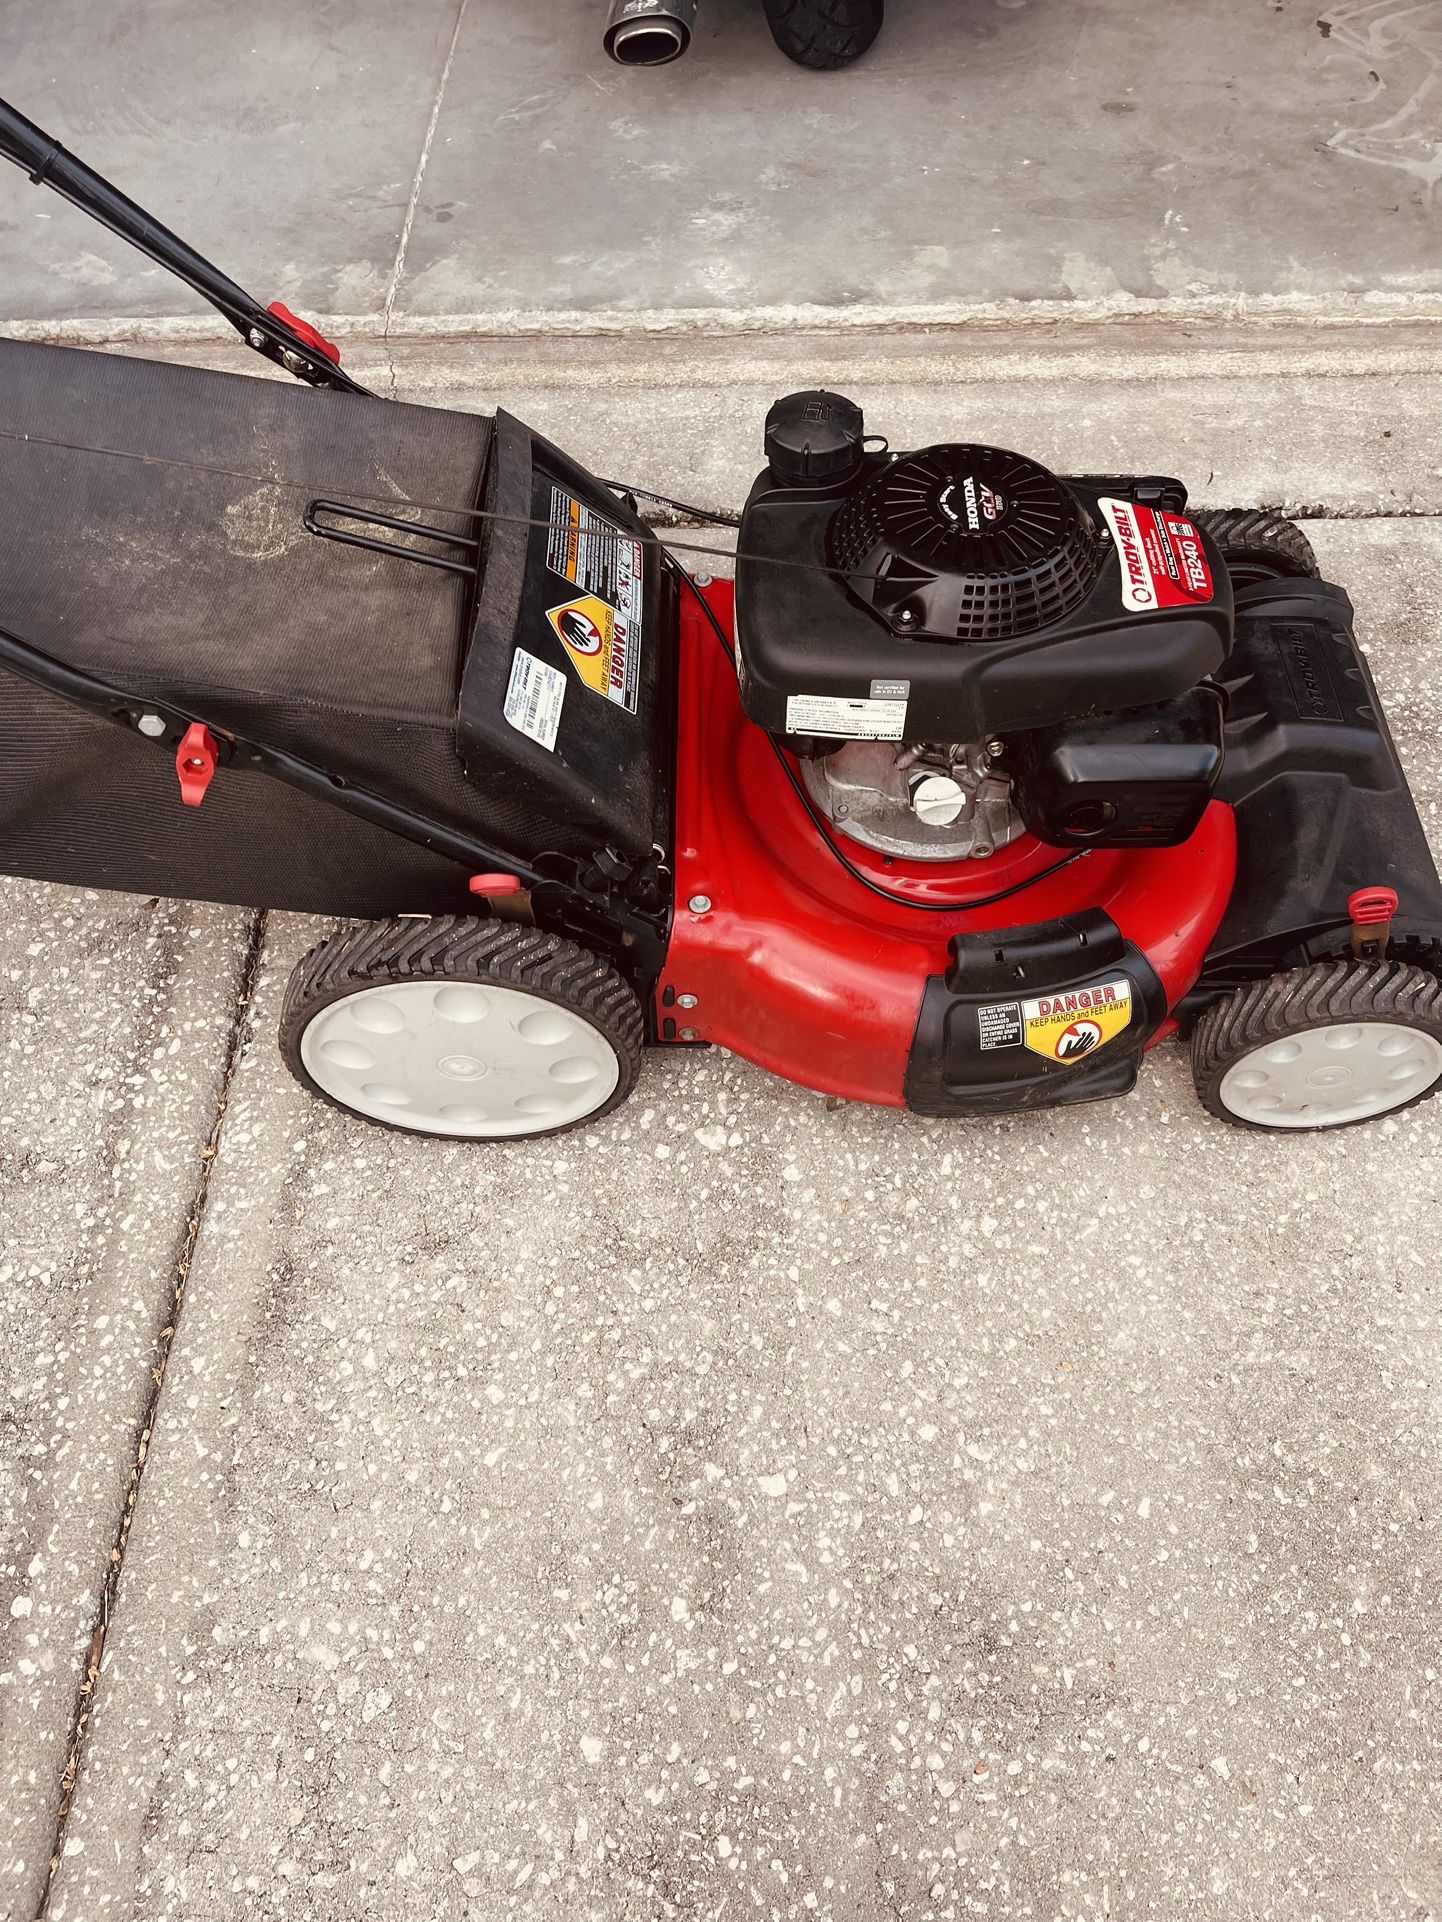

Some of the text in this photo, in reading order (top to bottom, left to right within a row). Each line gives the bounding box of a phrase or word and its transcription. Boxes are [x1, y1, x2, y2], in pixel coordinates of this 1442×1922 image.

[963, 476, 980, 530] HONDA
[980, 482, 996, 520] GCV
[1182, 540, 1208, 590] TB240
[604, 624, 612, 646] HANDS
[610, 622, 627, 690] DANGER
[1030, 1000, 1128, 1028] KEEP HANDS and FEET AWAY
[1038, 986, 1116, 1016] DANGER
[982, 1024, 1005, 1032] DISCHARGE
